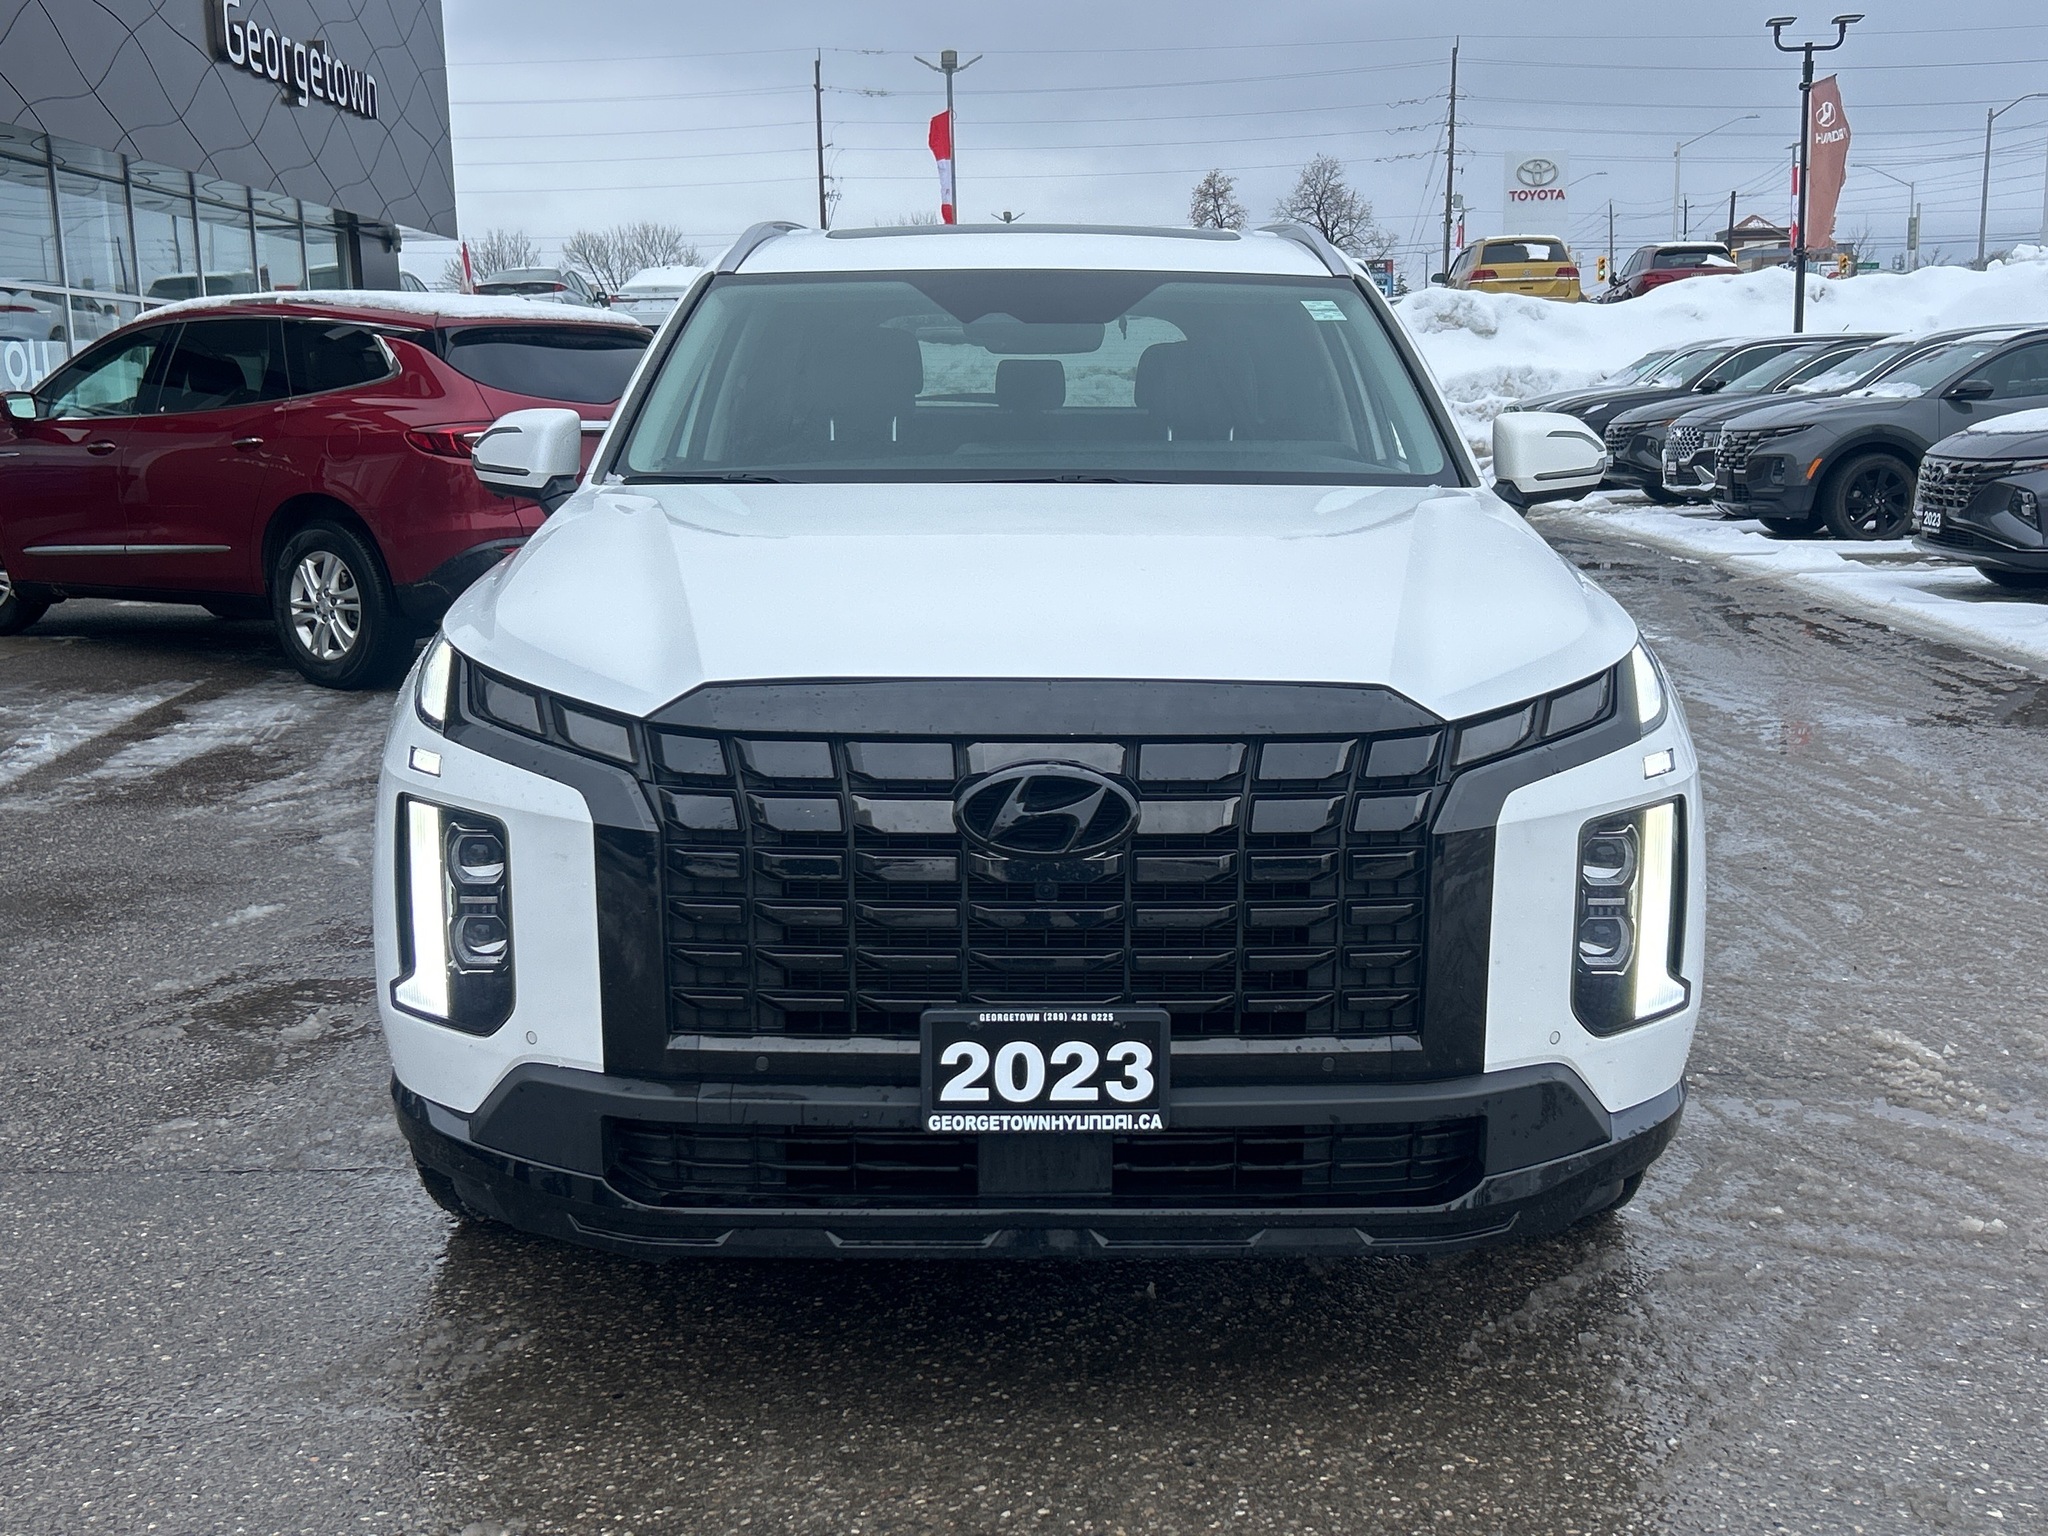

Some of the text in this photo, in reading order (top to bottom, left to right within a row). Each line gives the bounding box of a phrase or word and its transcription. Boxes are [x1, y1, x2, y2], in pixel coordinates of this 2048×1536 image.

[223, 0, 379, 119] Georgetown
[1508, 189, 1566, 202] TOYOTA
[1923, 510, 1941, 528] 2023
[979, 1012, 1114, 1022] GEORGETOWN (289) 428 0225
[939, 1040, 1155, 1103] 2023
[927, 1113, 1164, 1132] GEORGETOWNHYUNDAI.CA
